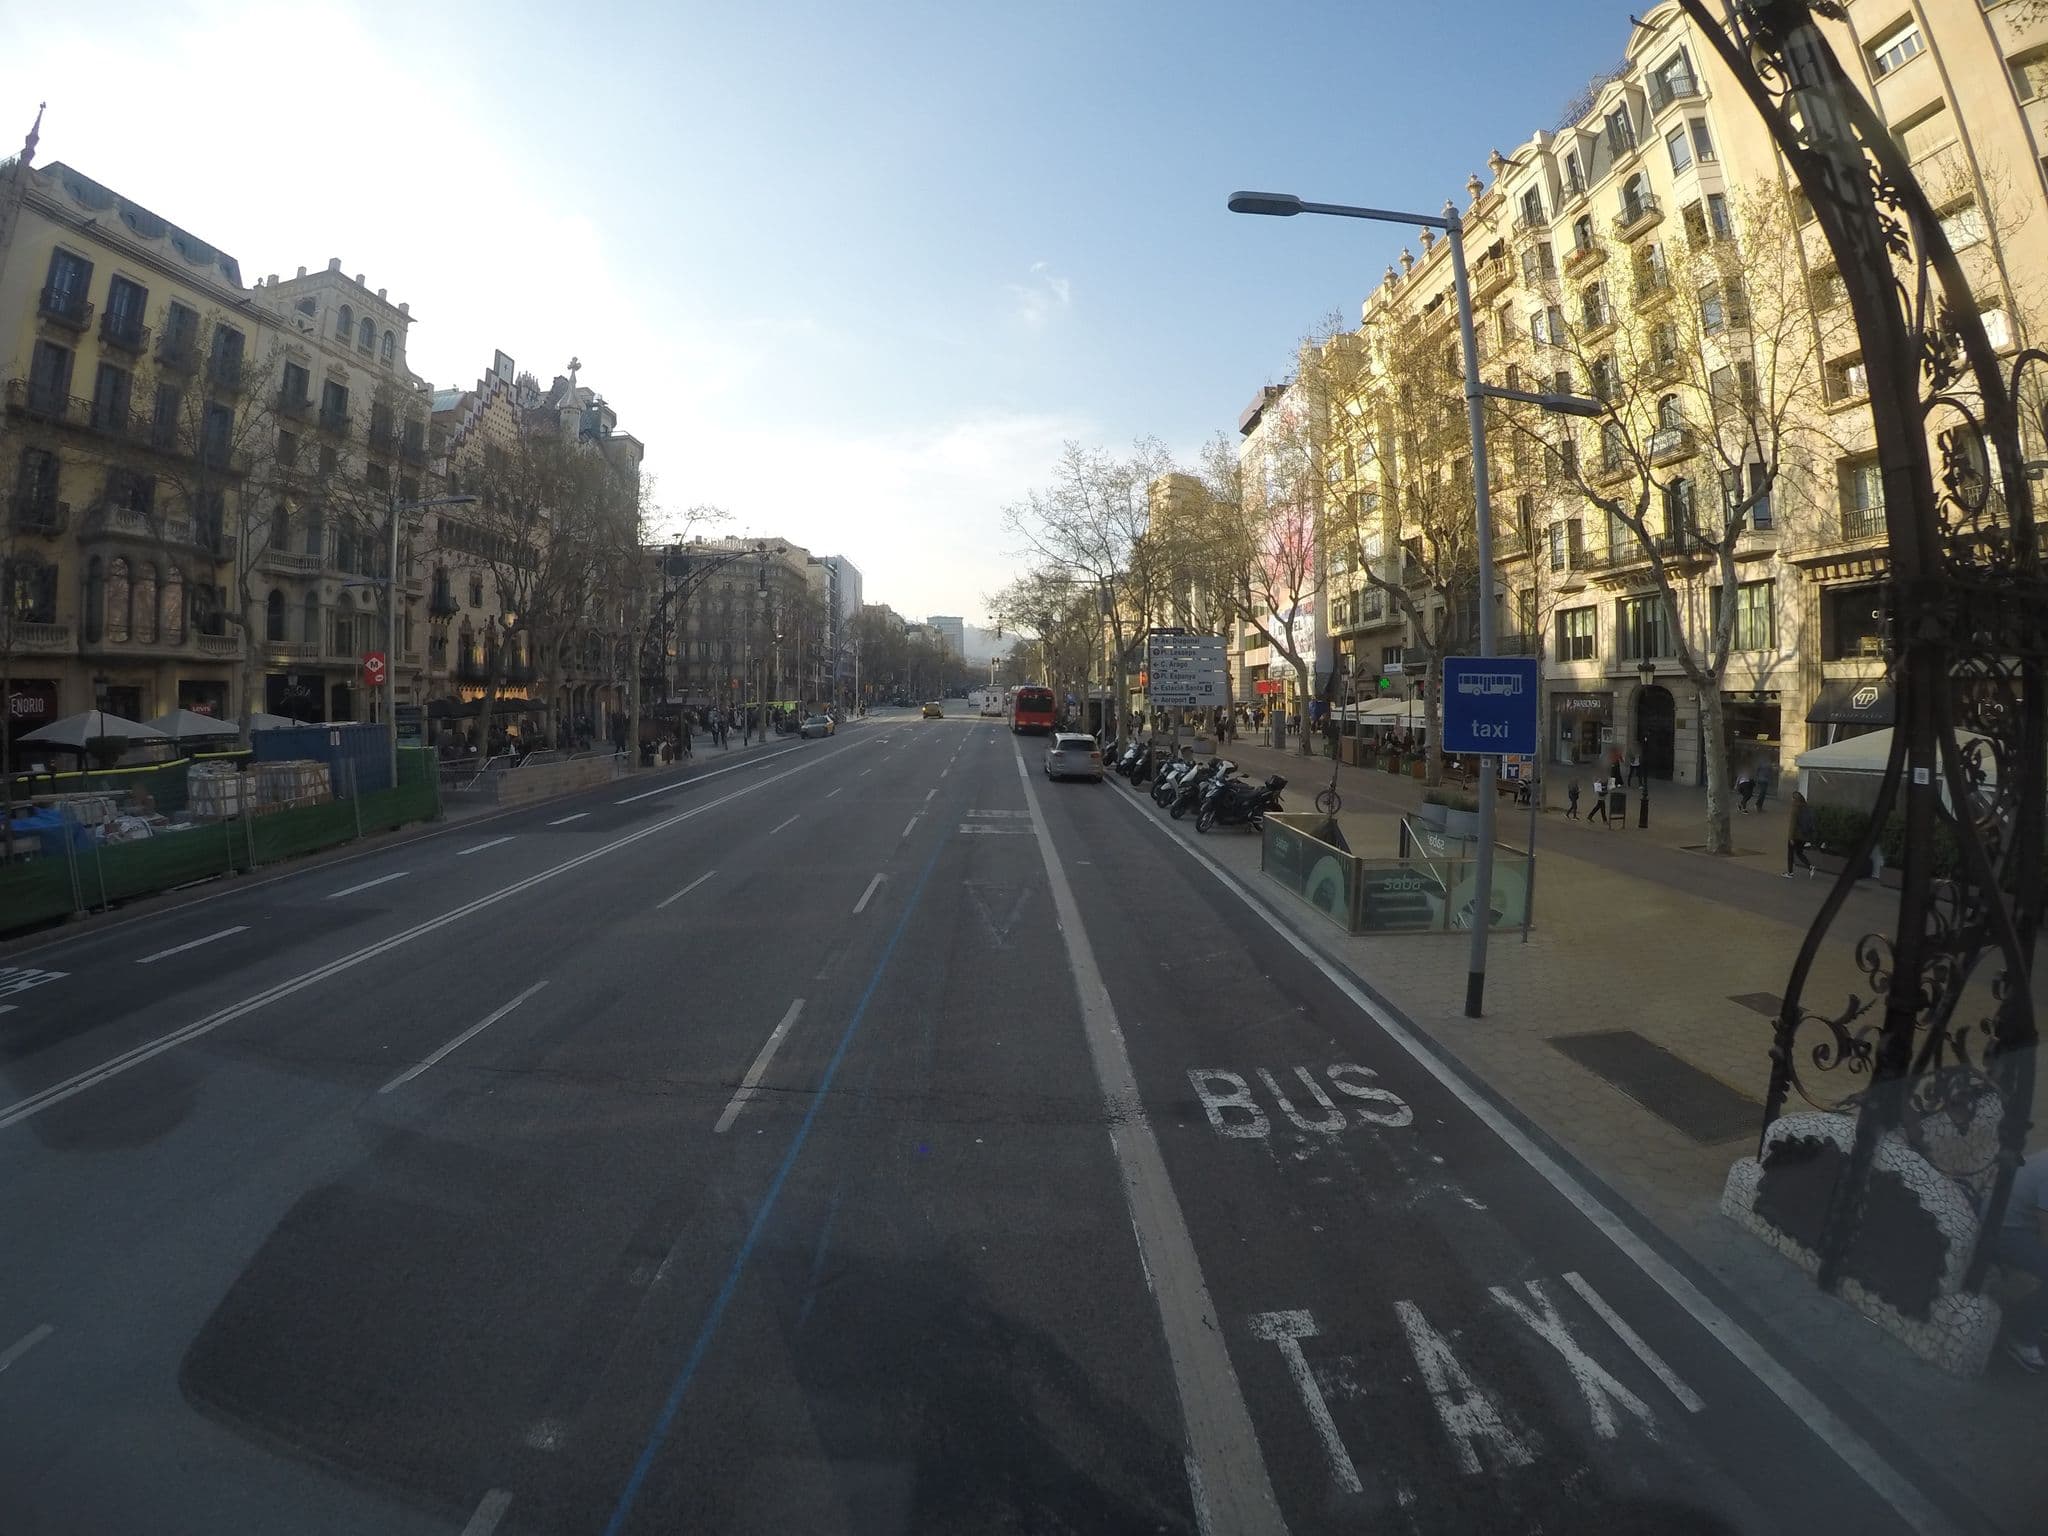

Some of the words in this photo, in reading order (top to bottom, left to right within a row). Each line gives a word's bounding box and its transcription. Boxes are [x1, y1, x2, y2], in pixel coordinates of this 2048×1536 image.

[1471, 719, 1509, 738] taxi
[1186, 1063, 1414, 1139] BUS
[1247, 1271, 1706, 1494] TAXI
